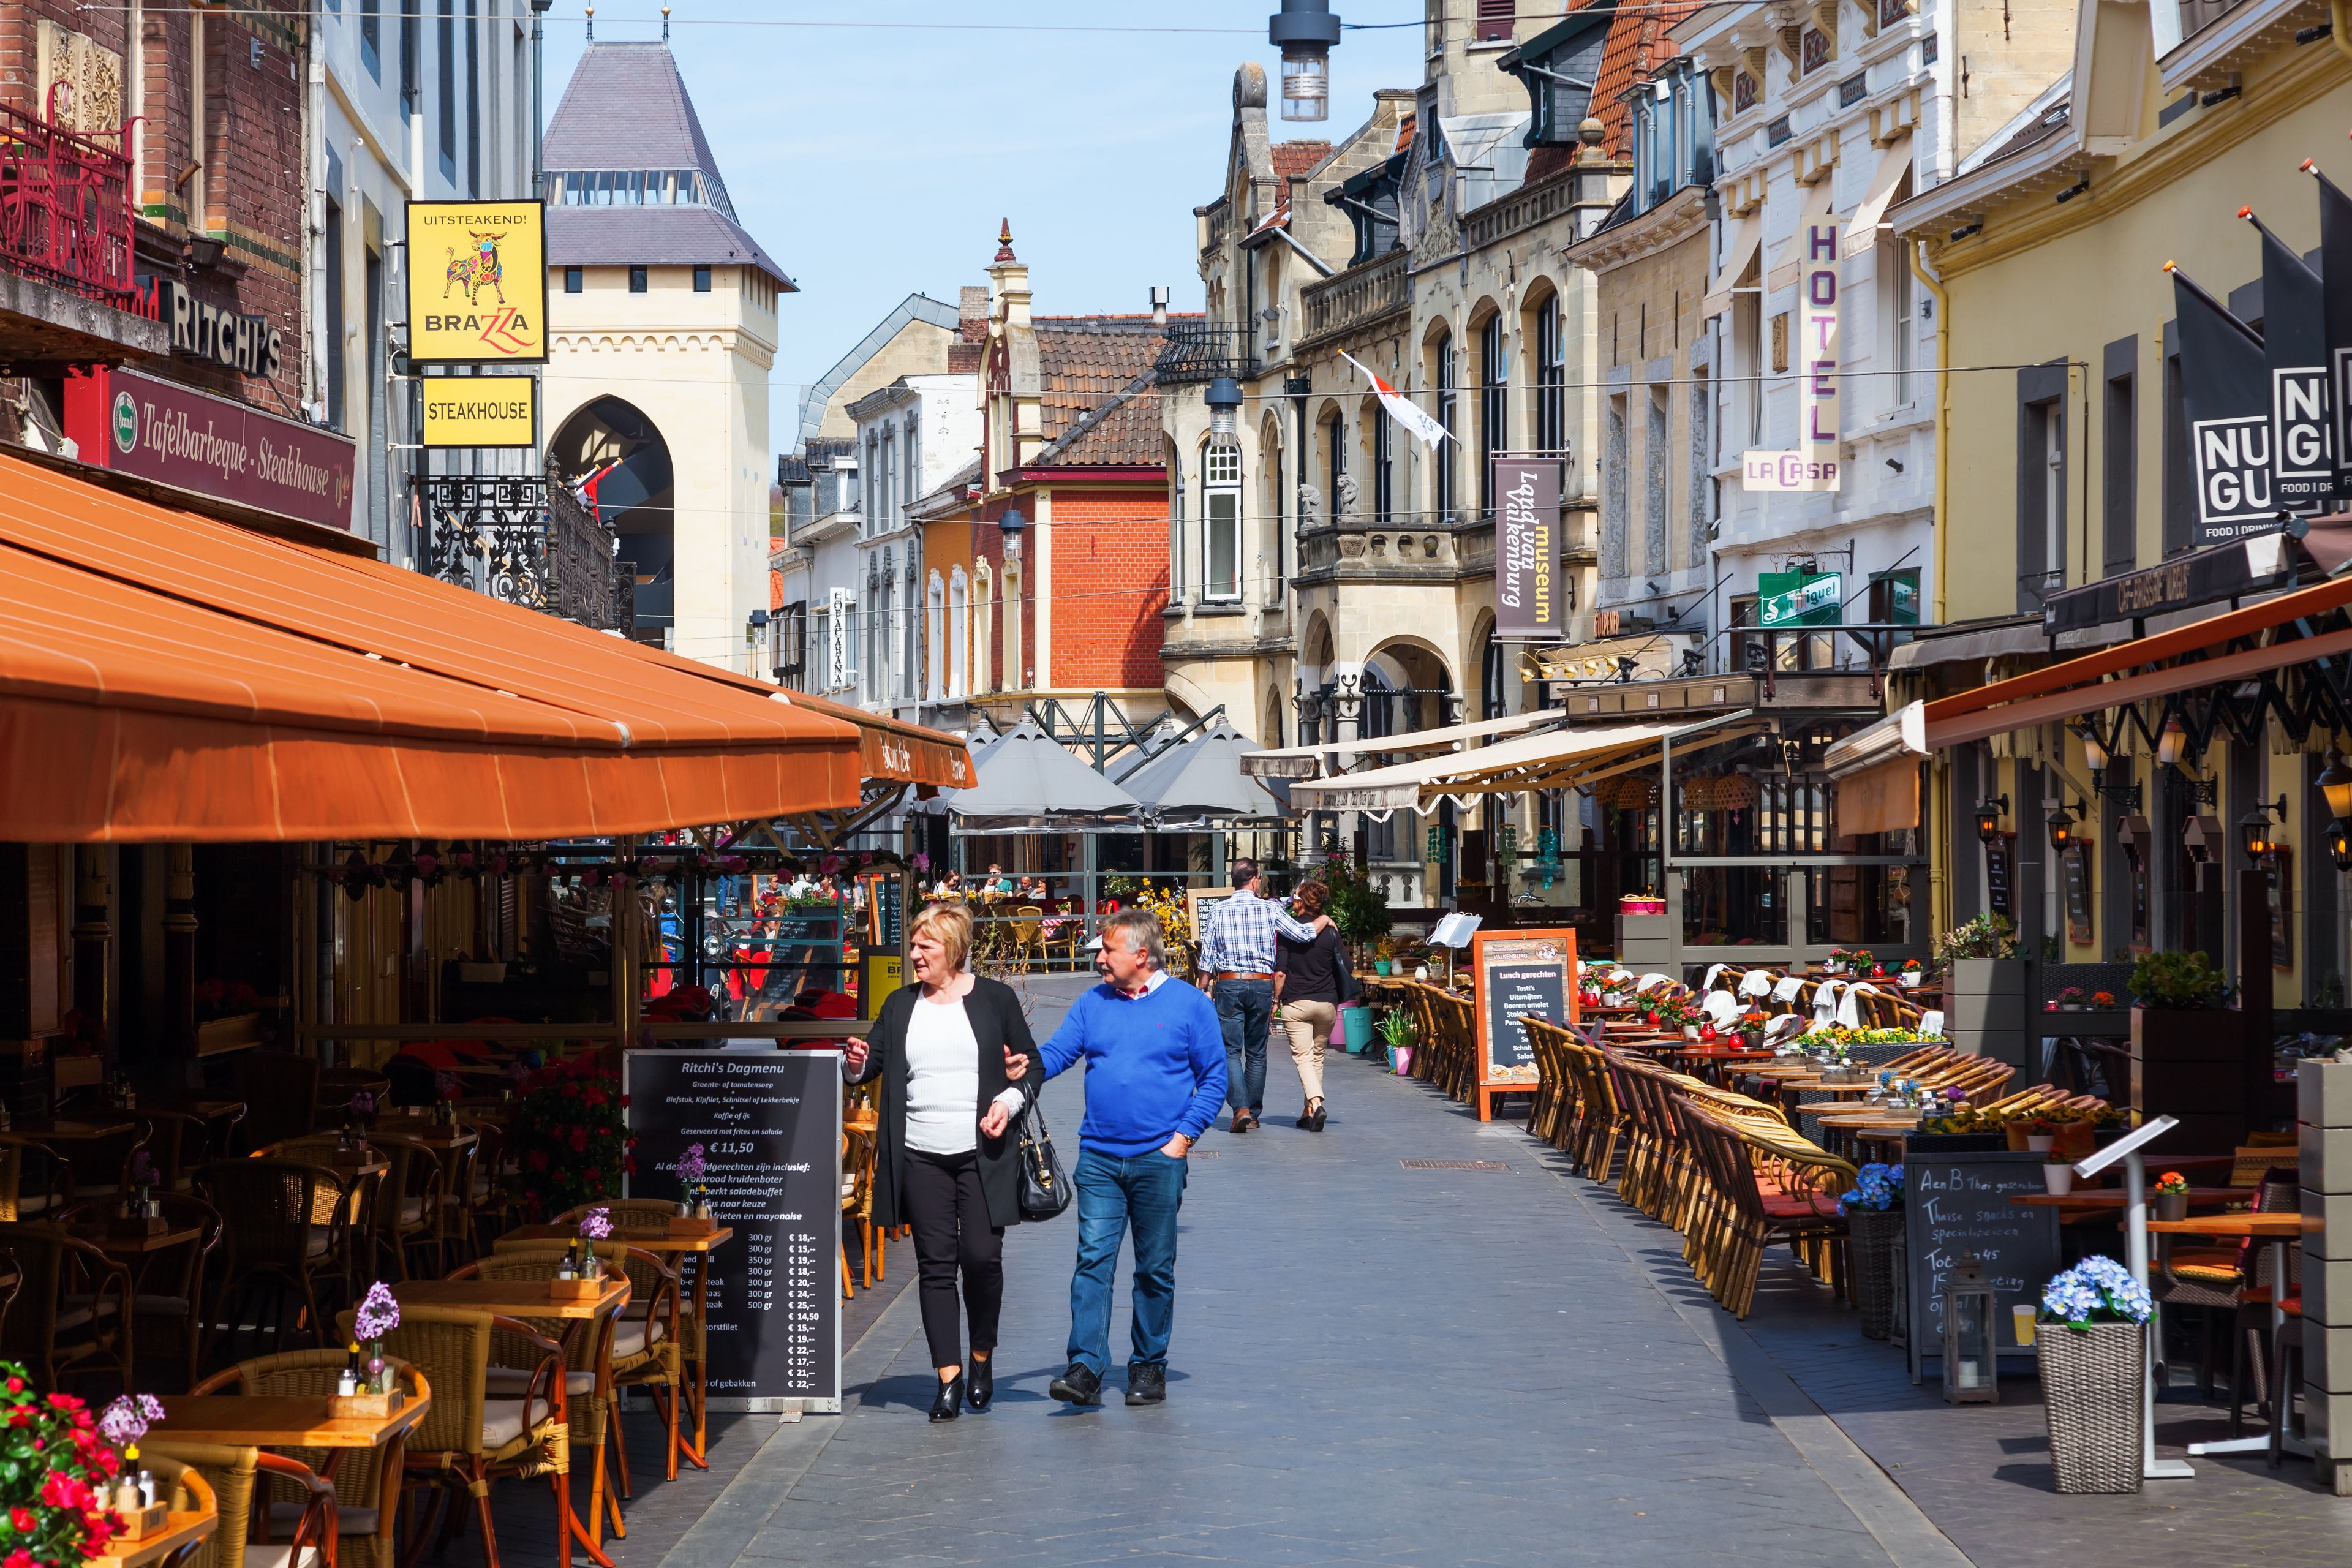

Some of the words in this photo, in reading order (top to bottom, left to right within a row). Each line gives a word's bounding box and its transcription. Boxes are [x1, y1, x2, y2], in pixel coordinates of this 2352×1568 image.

[423, 215, 527, 225] UITSTEAKEND!
[172, 280, 281, 380] RITCHI'S
[425, 307, 538, 354] BRAZZA
[1810, 225, 1836, 441] HOTEL
[429, 402, 527, 420] STEAKHOUSE
[143, 402, 247, 480] Tafelbarbeque
[257, 437, 330, 496] Steakhouse
[1747, 462, 1773, 480] LA
[1779, 454, 1836, 488] CASA
[1521, 471, 1539, 524] Land
[2209, 469, 2271, 511] GU
[2280, 483, 2310, 493] FOOD
[2206, 527, 2233, 538] FOOD
[1501, 488, 1525, 608] Valkenburg
[1521, 530, 1534, 570] van
[1536, 526, 1550, 623] museum
[1521, 971, 1556, 979] gerechten
[682, 1063, 723, 1074] Ritchi's
[727, 1063, 784, 1076] Dagmenu
[710, 1142, 718, 1153] €
[720, 1142, 753, 1154] 11,50
[756, 1163, 771, 1172] zijn
[772, 1163, 810, 1172] inclusief:
[1950, 1169, 1963, 1191] B
[1967, 1174, 1991, 1190] Thai
[690, 1188, 727, 1196] nbperkt
[729, 1188, 782, 1196] saladebuffet
[714, 1212, 741, 1221] frieten
[756, 1212, 802, 1222] mayonaise
[1922, 1197, 1964, 1225] Thaise
[797, 1313, 819, 1322] 14,50
[720, 1380, 756, 1389] gebakken
